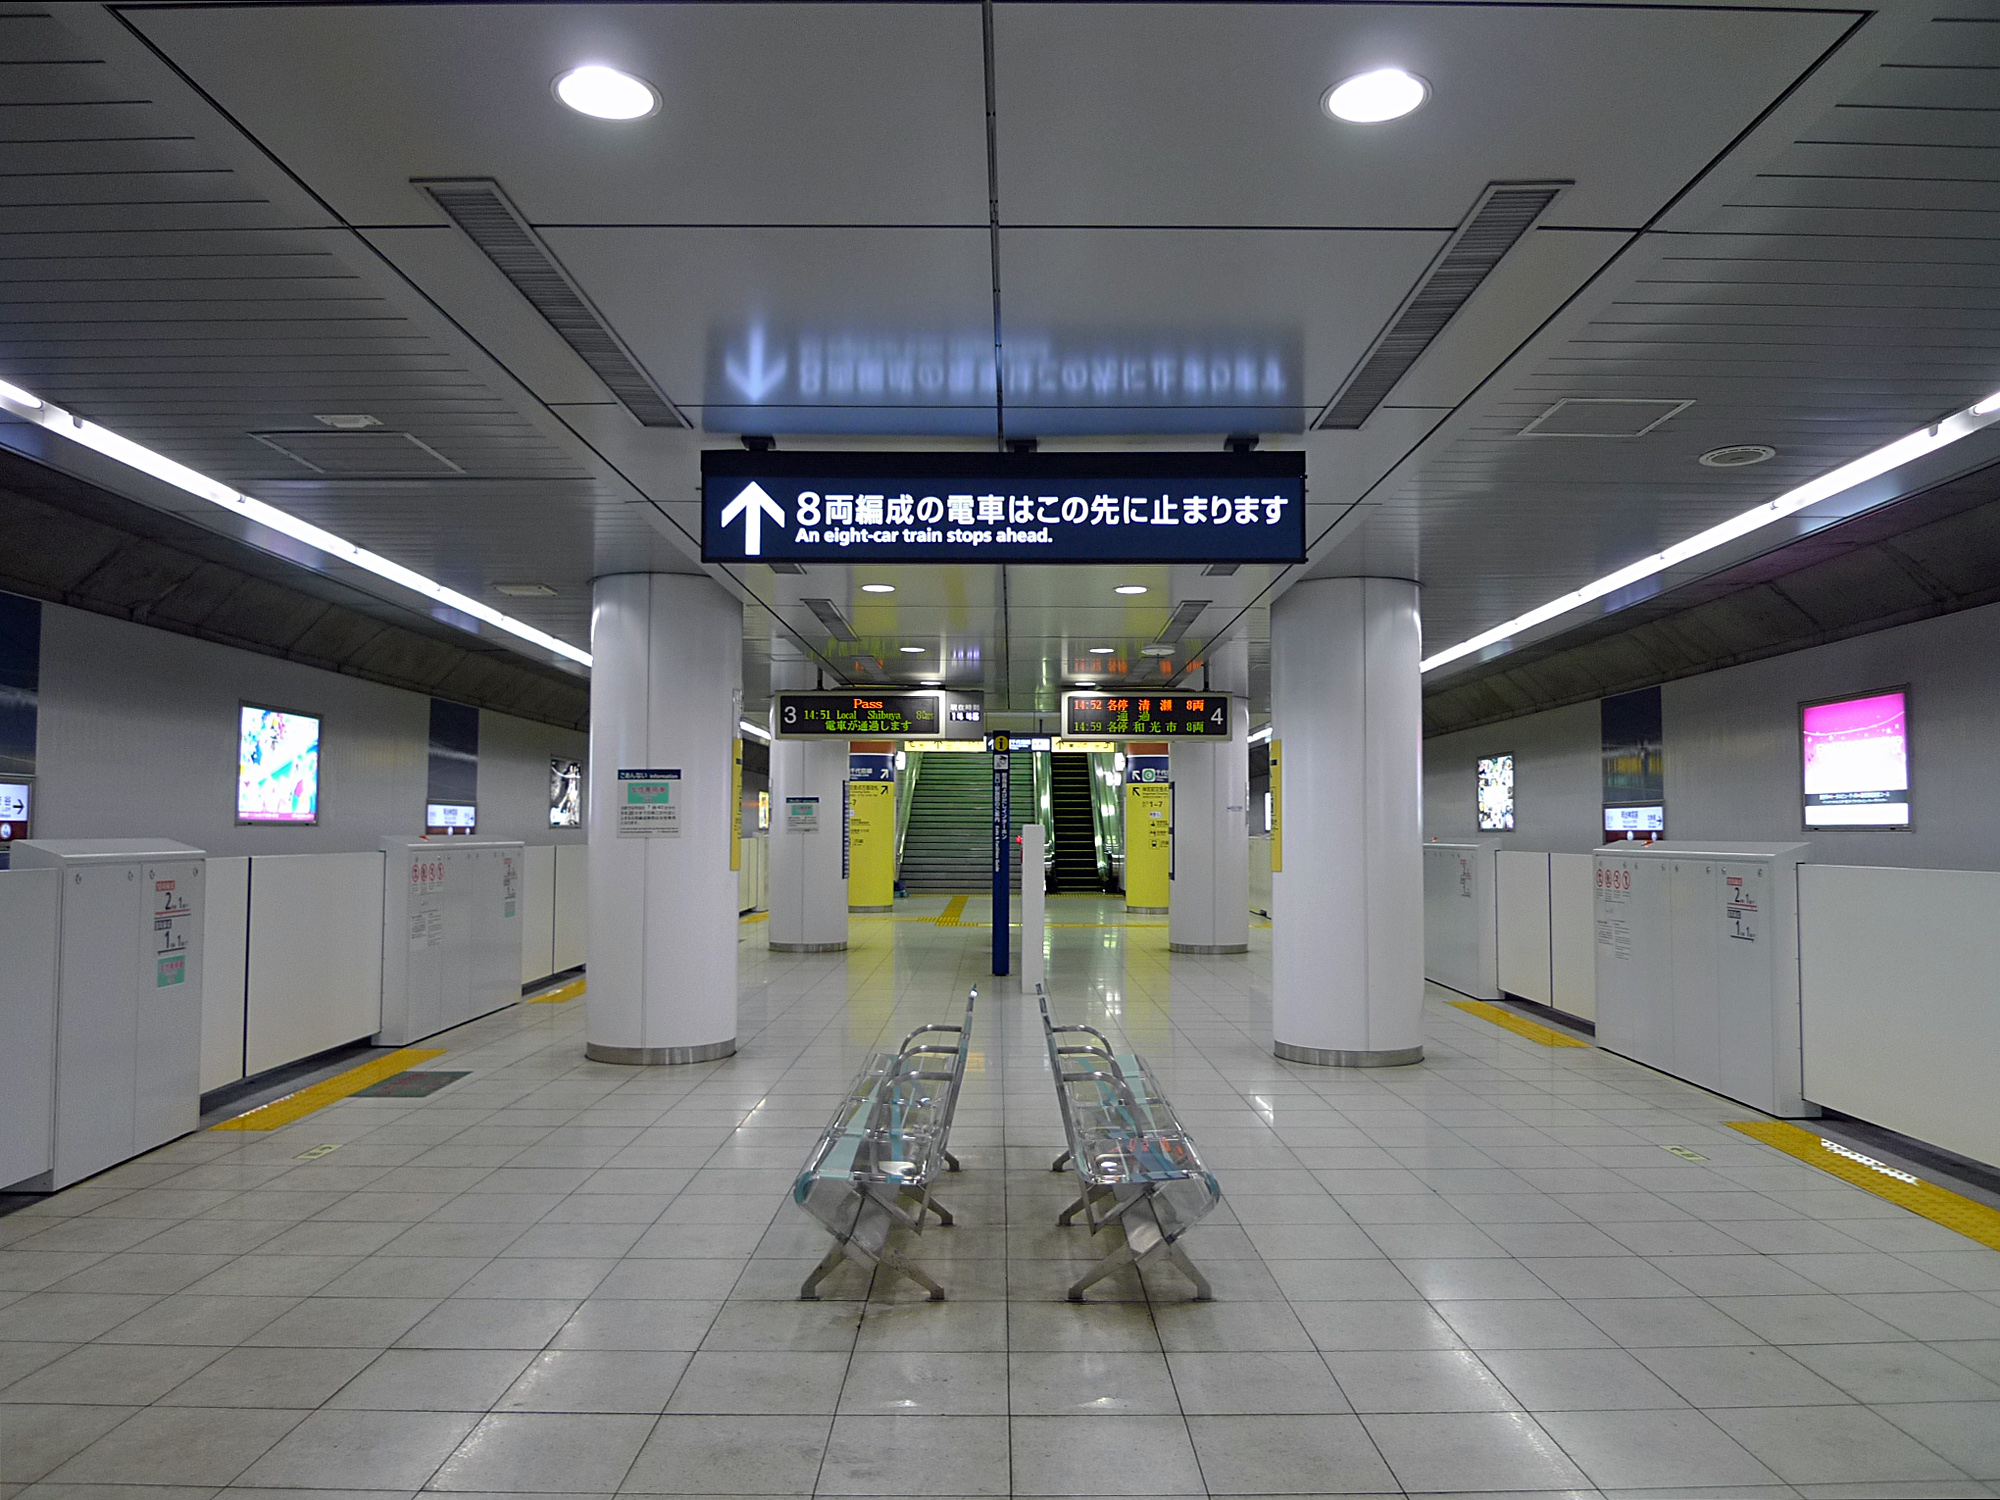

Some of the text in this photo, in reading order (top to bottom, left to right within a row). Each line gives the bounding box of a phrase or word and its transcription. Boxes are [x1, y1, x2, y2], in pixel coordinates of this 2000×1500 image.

[796, 491, 1289, 526] 8両編成の電車はこの先に止まります
[795, 527, 1053, 546] An eight-car train stops ahead.
[853, 699, 883, 709] Pass
[1074, 700, 1102, 710] 14:52
[1107, 699, 1129, 711] 各停
[1186, 700, 1205, 711] 8両
[784, 706, 797, 723] 3
[804, 710, 831, 720] 14:51
[836, 710, 857, 720] Local
[867, 710, 901, 721] Shibuya
[1210, 707, 1224, 725] 4
[825, 720, 912, 732] 電車が通過します
[1074, 722, 1102, 732] 14:59
[1186, 722, 1204, 732] 8両
